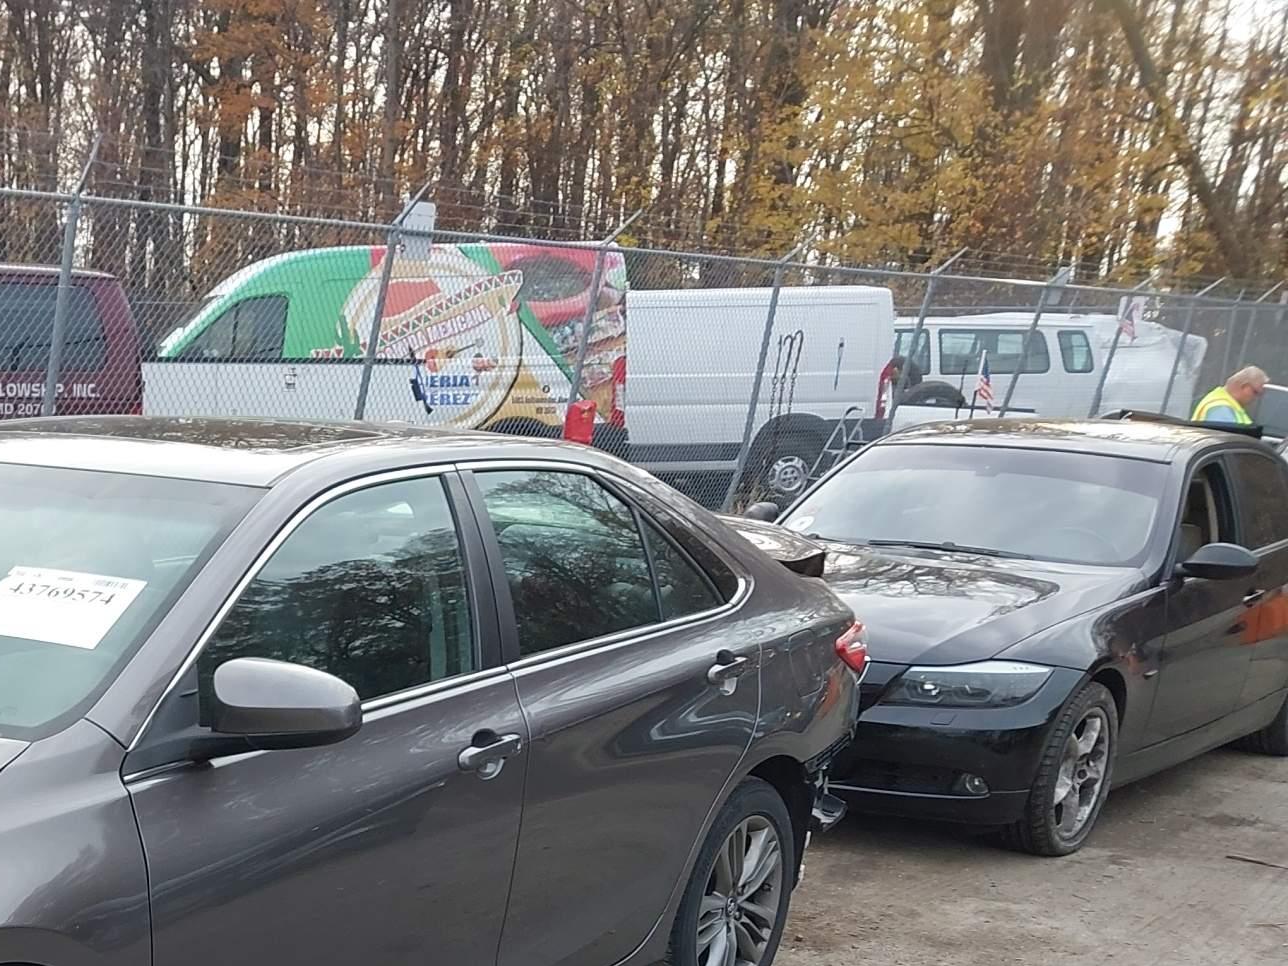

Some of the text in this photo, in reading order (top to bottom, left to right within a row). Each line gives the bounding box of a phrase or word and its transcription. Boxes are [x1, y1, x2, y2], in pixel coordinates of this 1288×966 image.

[426, 304, 492, 343] MEXICANA
[73, 383, 100, 398] INC.
[428, 390, 470, 405] ÉREZ
[18, 404, 57, 416] 207
[9, 582, 116, 605] 43769574
